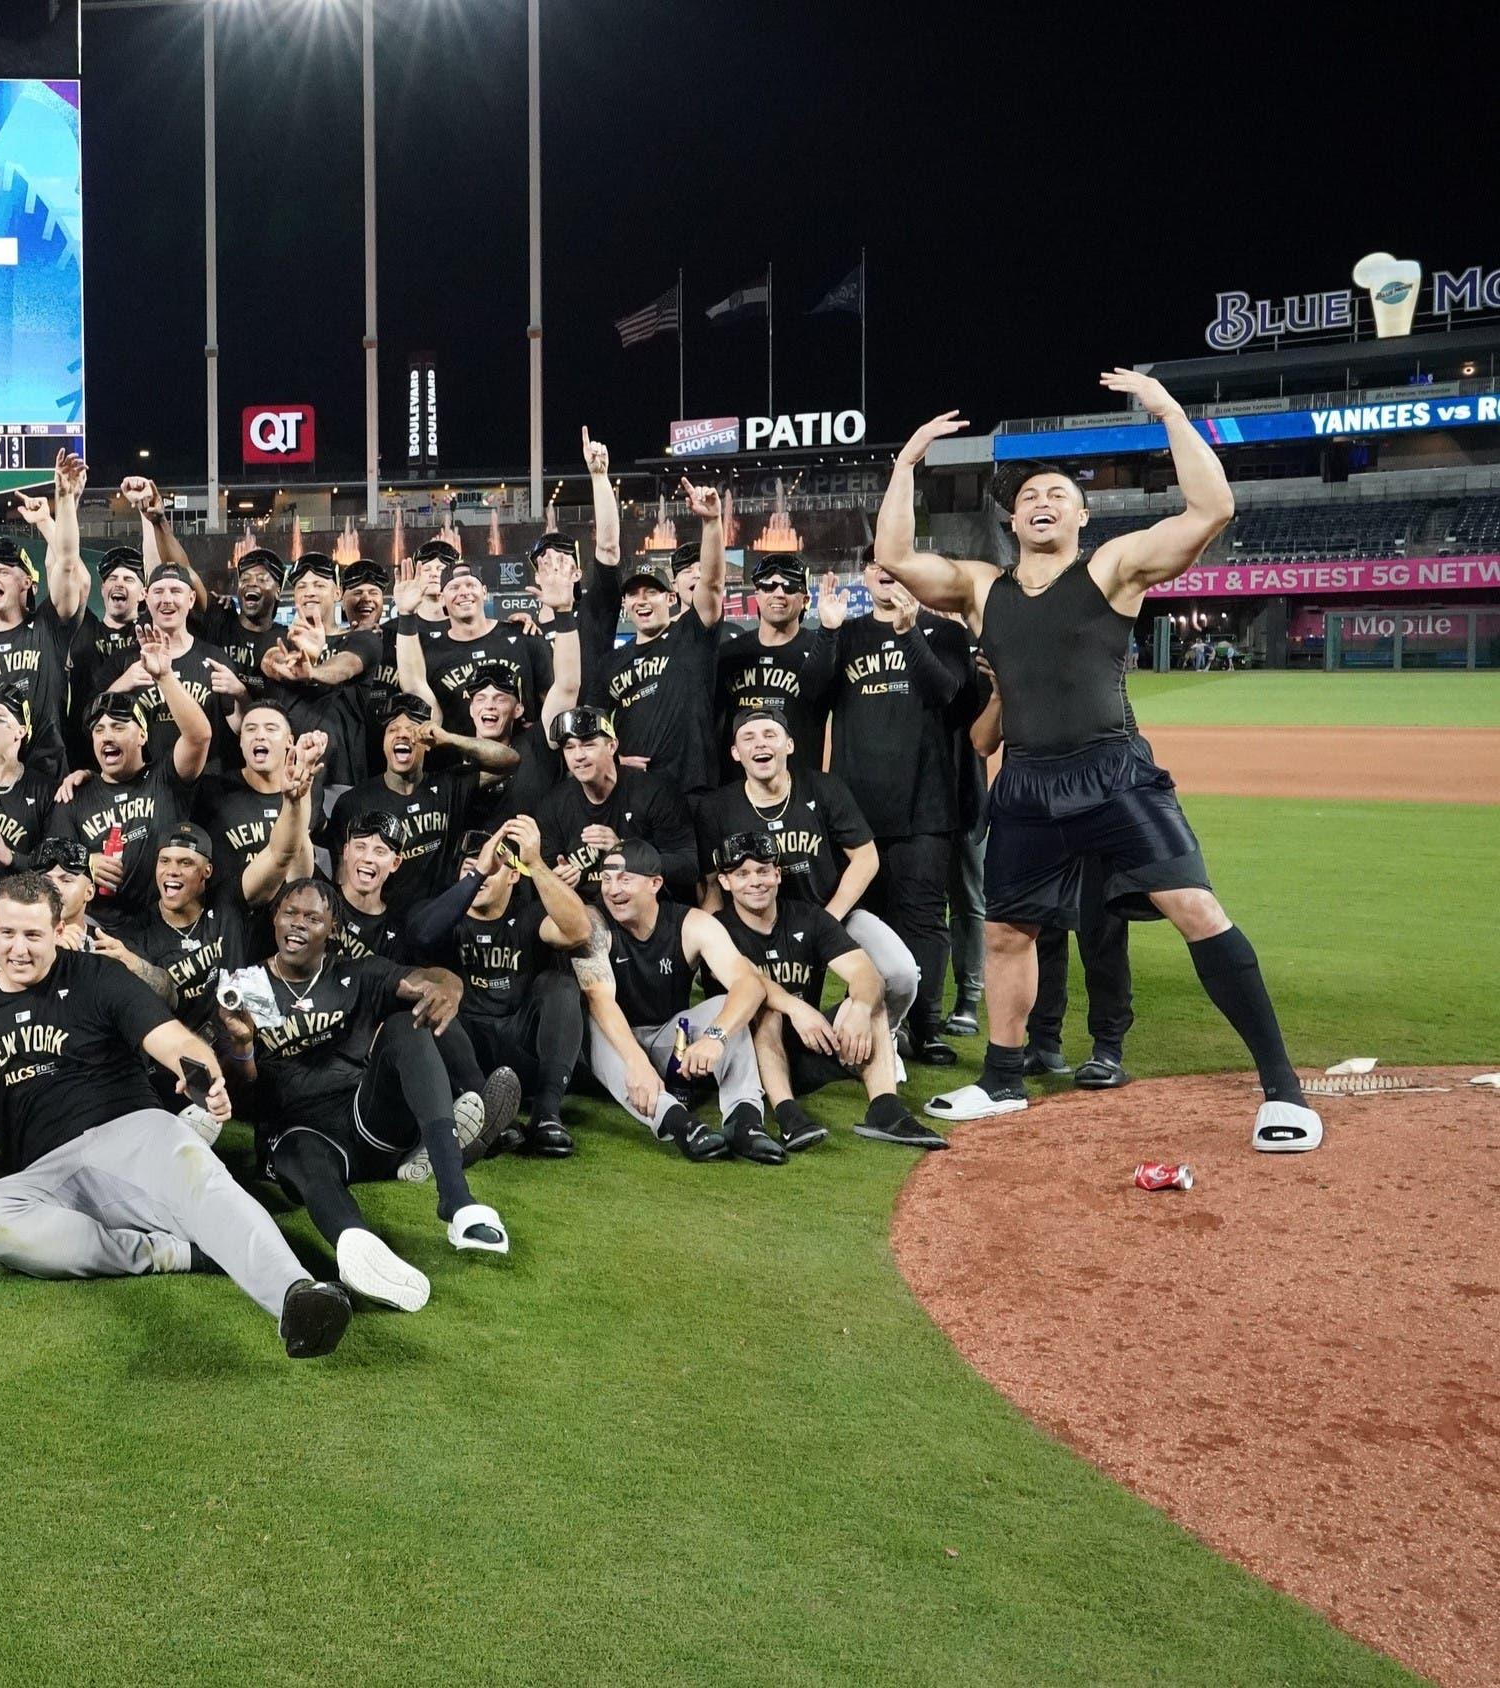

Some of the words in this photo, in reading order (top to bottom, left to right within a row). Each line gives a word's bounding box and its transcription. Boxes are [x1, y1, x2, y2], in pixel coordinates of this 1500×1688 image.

[1205, 289, 1351, 351] BLUE
[409, 370, 420, 457] BOULEVARD
[428, 370, 438, 456] BOULEVARD
[1311, 402, 1430, 435] YANKEES
[1437, 405, 1471, 420] vs
[1477, 396, 1500, 421] R
[251, 412, 302, 453] QT
[673, 420, 713, 440] PRICE
[673, 429, 736, 455] CHOPPER
[746, 409, 866, 450] PATIO
[11, 438, 19, 452] 3
[11, 454, 19, 468] 3
[1225, 573, 1243, 590] &
[1250, 567, 1365, 590] FASTEST
[1371, 564, 1410, 586] 5G
[4, 650, 41, 672] YORK
[845, 653, 880, 684] NEW
[441, 662, 474, 691] NEW
[639, 682, 658, 697] 2024
[861, 683, 888, 694] ALCS
[887, 682, 908, 690] 2024
[739, 696, 765, 708] ALCS
[764, 698, 785, 706] 2024
[81, 807, 117, 840] NEW
[119, 797, 155, 824] YORK
[414, 811, 449, 834] YORK
[126, 825, 148, 841] 2024
[225, 822, 267, 850] NEW
[775, 831, 822, 856] YORK
[400, 845, 425, 860] ALCS
[482, 946, 522, 970] YORK
[20, 1024, 69, 1056] YORK
[259, 1017, 300, 1051] NEW
[4, 1065, 36, 1087] ALCS
